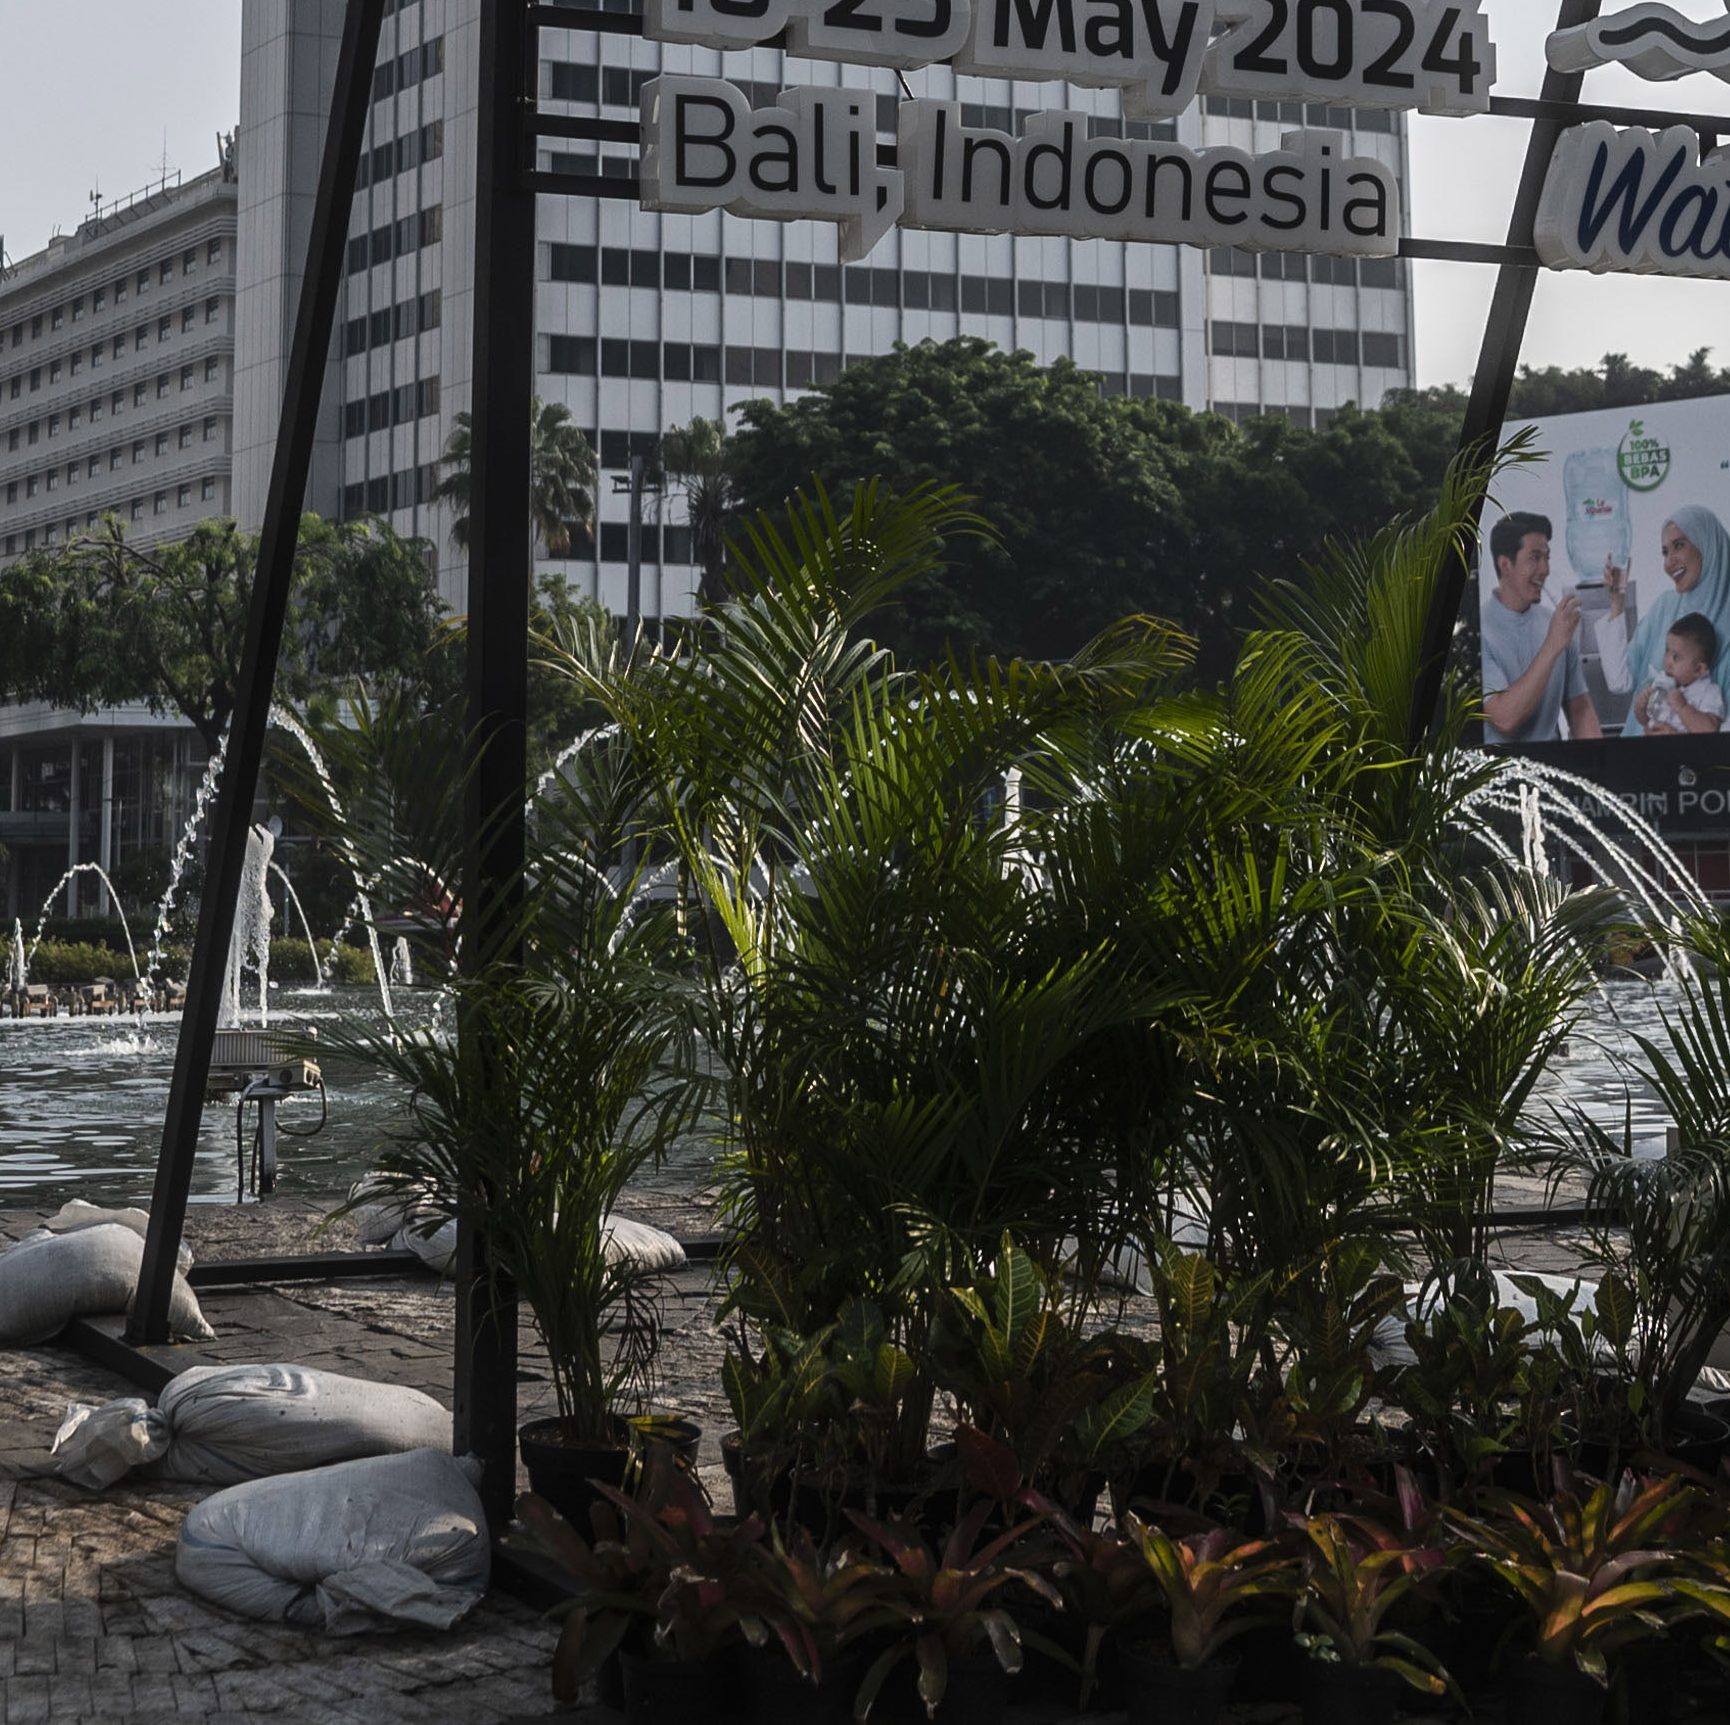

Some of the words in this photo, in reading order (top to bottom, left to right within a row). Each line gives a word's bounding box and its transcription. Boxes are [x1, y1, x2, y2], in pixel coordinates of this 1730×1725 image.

[672, 91, 889, 207] Bali,
[931, 107, 1390, 240] Indonesia
[1629, 438, 1658, 451] 100%
[1623, 449, 1667, 466] BEBAS
[1630, 464, 1660, 480] BPA
